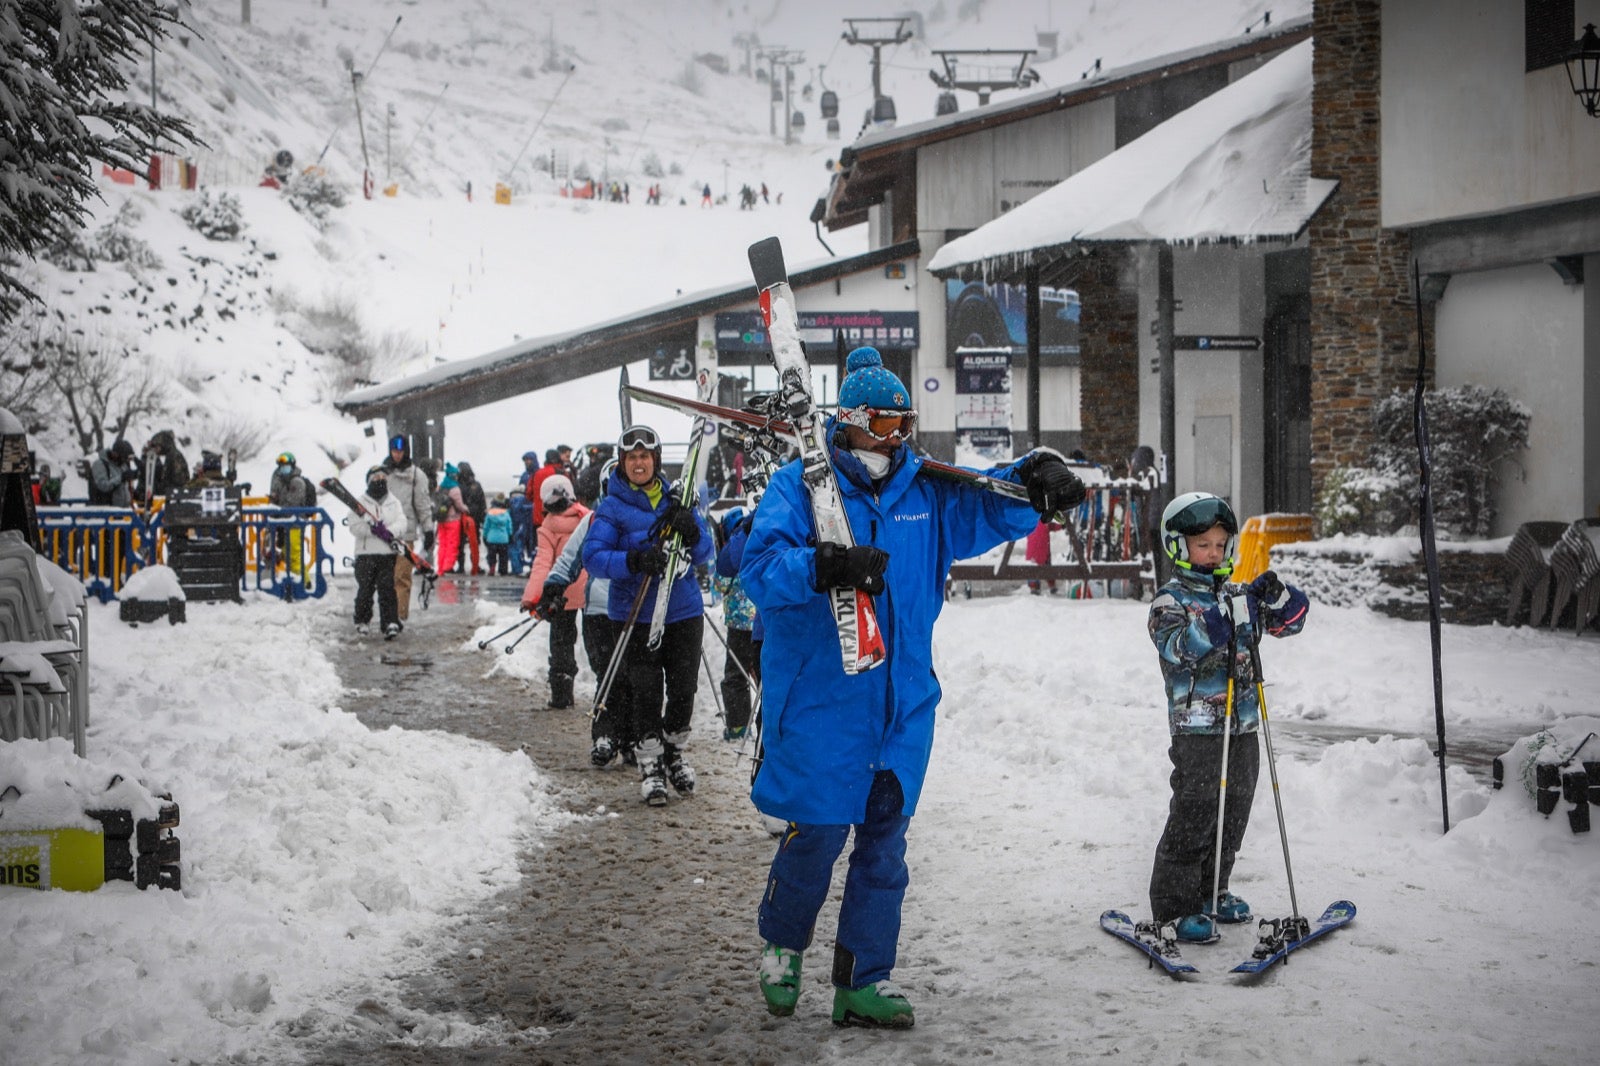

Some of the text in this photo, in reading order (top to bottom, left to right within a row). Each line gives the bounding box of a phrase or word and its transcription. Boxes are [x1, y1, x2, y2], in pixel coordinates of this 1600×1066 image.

[1001, 178, 1065, 188] sierranevad
[963, 356, 1007, 364] ALQUILER
[836, 587, 855, 622] LKL
